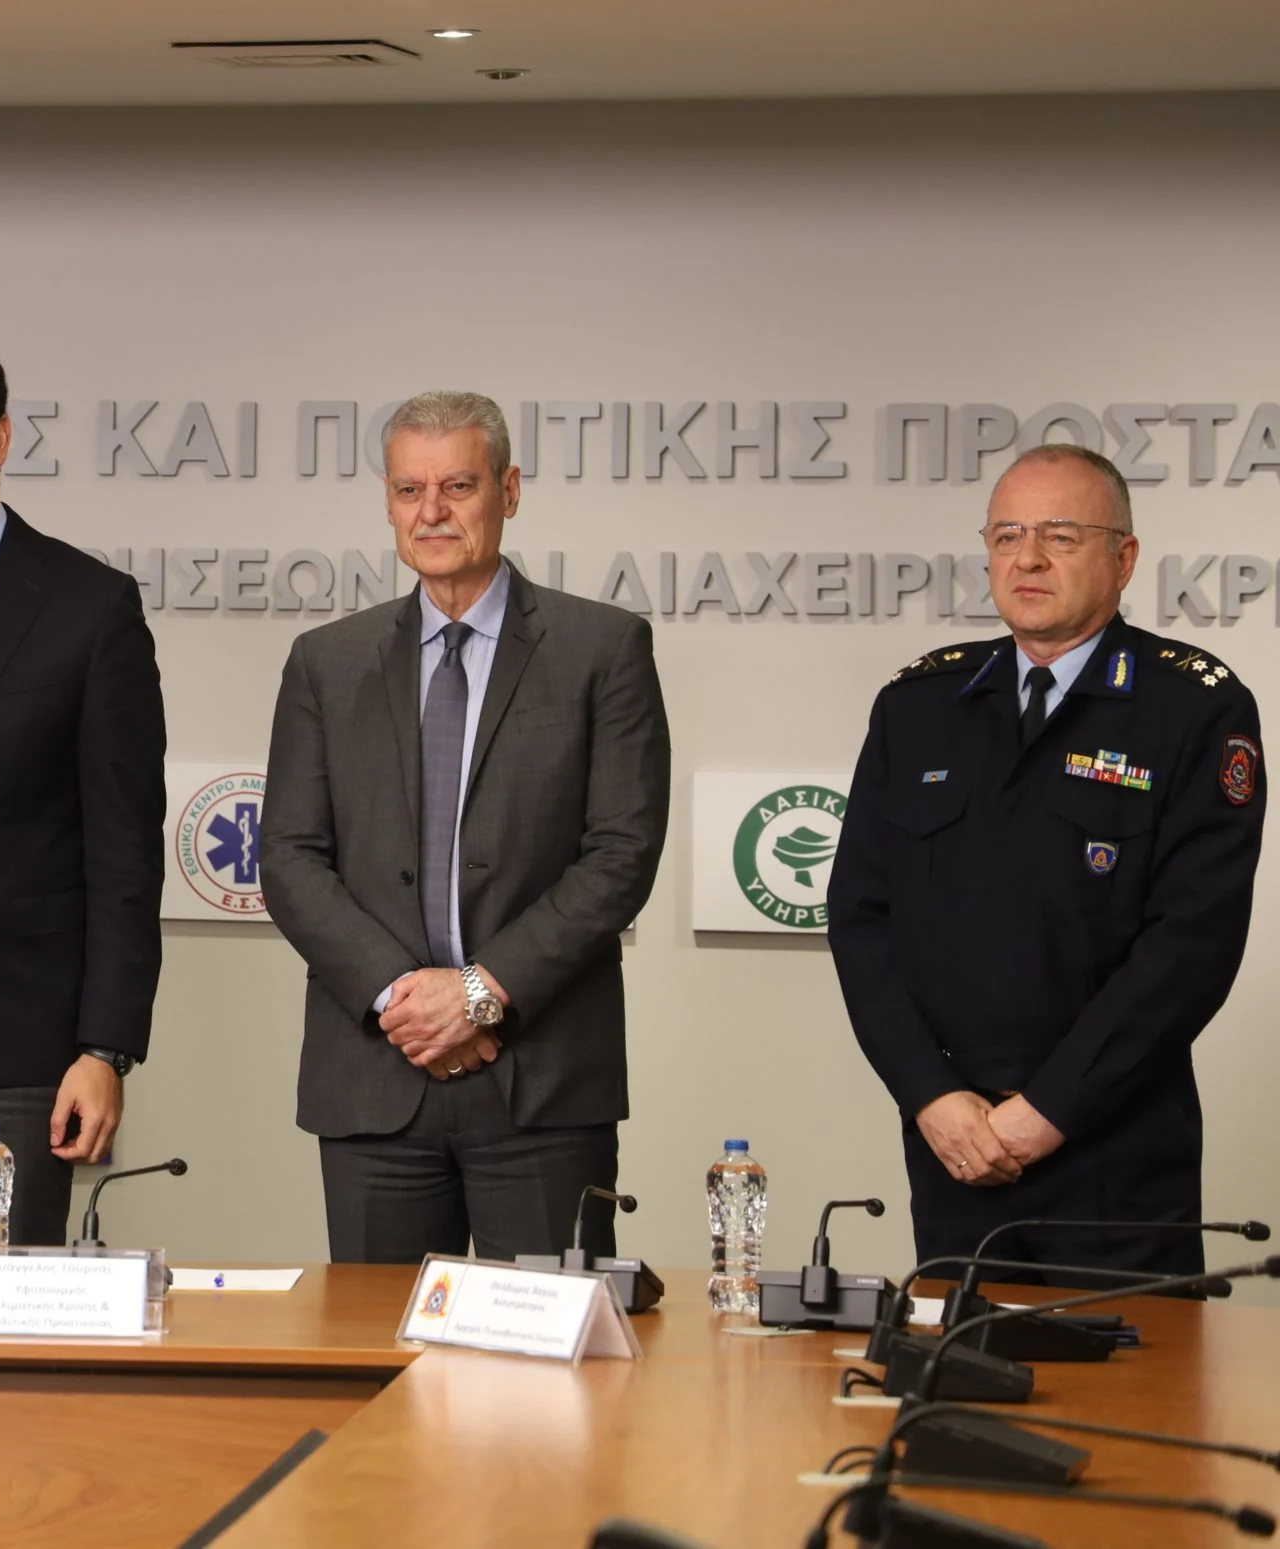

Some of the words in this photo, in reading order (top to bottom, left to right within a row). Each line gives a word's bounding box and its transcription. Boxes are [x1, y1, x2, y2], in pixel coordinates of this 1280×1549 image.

[97, 400, 258, 478] ΚΑΙ
[298, 400, 847, 480] ΠΙΤΙΚΗΣ
[599, 551, 1131, 618] ΔΙΑΧΕΙΡΙΣ
[1161, 554, 1280, 619] ΚΡ
[188, 780, 235, 820] ΚΕΝΤΡΟ
[759, 790, 846, 823] ΔΑΣΙΚ
[181, 823, 199, 877] ΕΘΝΙΚΟ
[746, 876, 828, 925] ΥΠΗΡΕ
